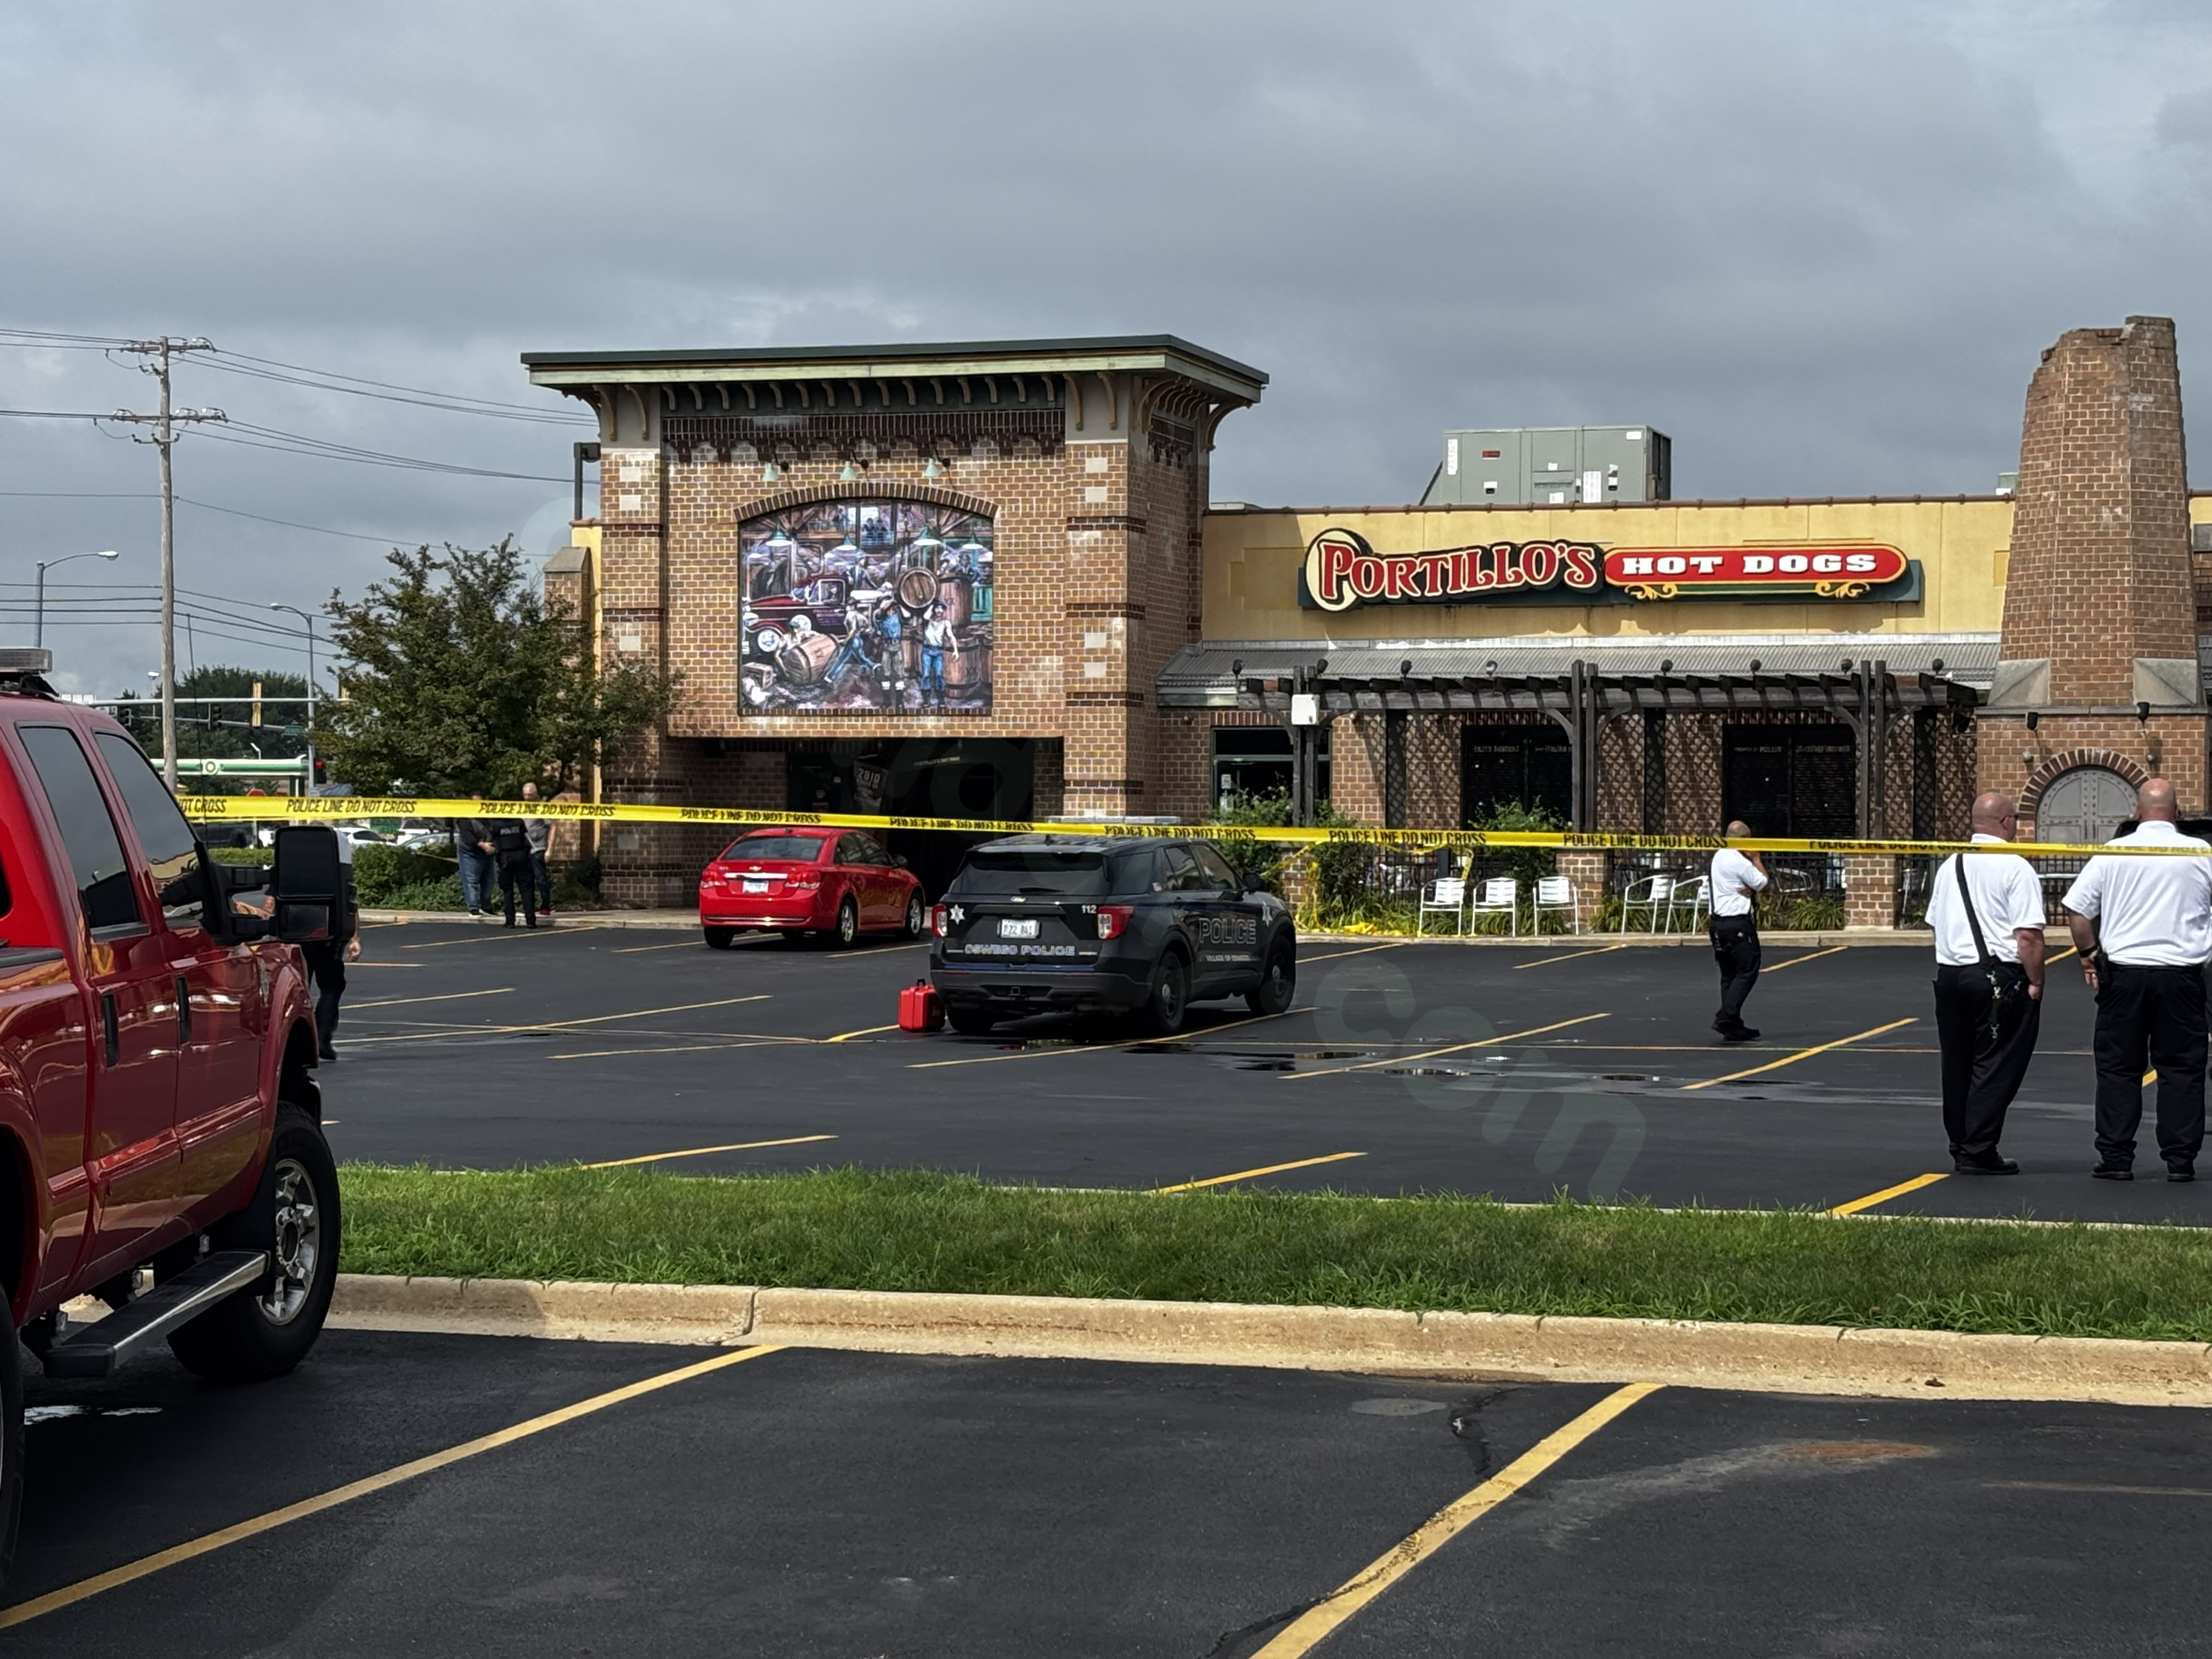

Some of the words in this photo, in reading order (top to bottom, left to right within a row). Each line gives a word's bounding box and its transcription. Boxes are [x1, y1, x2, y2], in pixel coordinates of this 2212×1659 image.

[1317, 540, 1598, 600] PORTILLO'S
[1622, 555, 1723, 575] HOT
[1742, 554, 1877, 573] DOGS
[194, 799, 227, 813] CROSS
[286, 799, 322, 812] POLICE
[323, 799, 343, 812] LINE
[346, 799, 360, 812] DO
[362, 800, 381, 813] NOT
[382, 801, 417, 814] CROSS
[478, 802, 517, 814] POLICE
[517, 803, 540, 815] LINE
[540, 804, 557, 815] DO
[557, 804, 579, 816] NOT
[580, 805, 616, 816] CROSS
[681, 809, 718, 820] POLICE
[720, 810, 743, 821] LINE
[744, 811, 762, 822] DO
[762, 812, 783, 822] NOT
[785, 813, 822, 823] CROSS
[1104, 825, 1143, 836] POLICE
[1148, 826, 1171, 837] LINE
[1174, 827, 1190, 838] DO
[1190, 828, 1214, 839] NOT
[1217, 829, 1256, 840] CROSS
[1329, 830, 1370, 842] POLICE
[1374, 831, 1399, 843] LINE
[1401, 832, 1418, 843] DO
[1419, 832, 1444, 844] NOT
[1446, 832, 1487, 844] CROSS
[1564, 833, 1607, 846] POLICE
[1610, 834, 1636, 847] LINE
[1639, 835, 1656, 848] DO
[1657, 836, 1681, 848] NOT
[1686, 837, 1728, 849] CROSS
[1081, 905, 1097, 914] 112
[1199, 918, 1256, 945] POLICE
[964, 944, 1018, 955] OSWEGO
[1021, 945, 1075, 956] POLICE
